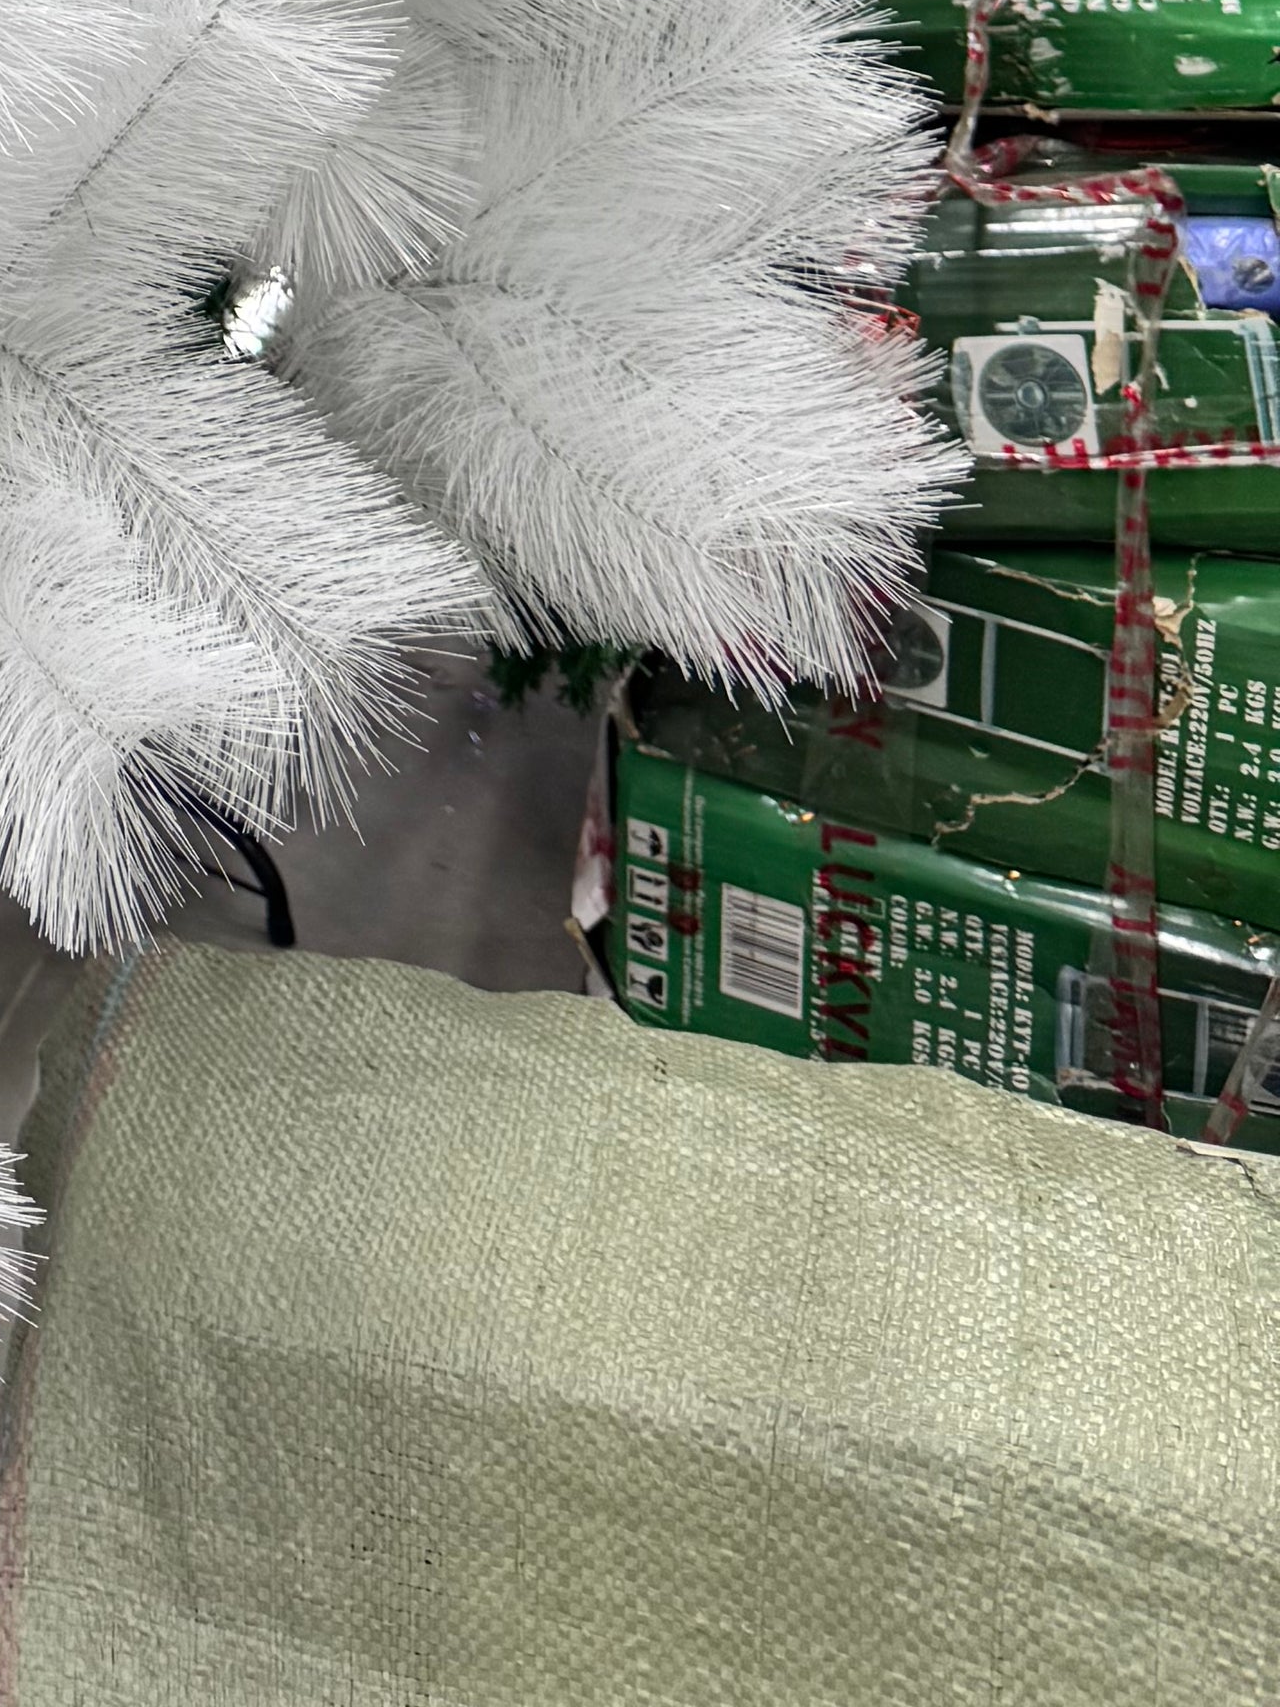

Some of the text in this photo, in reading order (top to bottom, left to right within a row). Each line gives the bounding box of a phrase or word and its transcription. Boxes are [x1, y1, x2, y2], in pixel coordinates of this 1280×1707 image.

[1218, 683, 1239, 714] PC
[1215, 732, 1235, 743] 1
[1235, 679, 1267, 843] N.W.: 2.4 KGS
[1155, 750, 1177, 818] MODEL:
[890, 895, 908, 969] COLOR:
[914, 968, 931, 1004] 3.0
[939, 972, 957, 1010] 2.4
[963, 1009, 982, 1020] 1
[912, 1019, 930, 1065] KGS
[962, 1039, 981, 1071] PC
